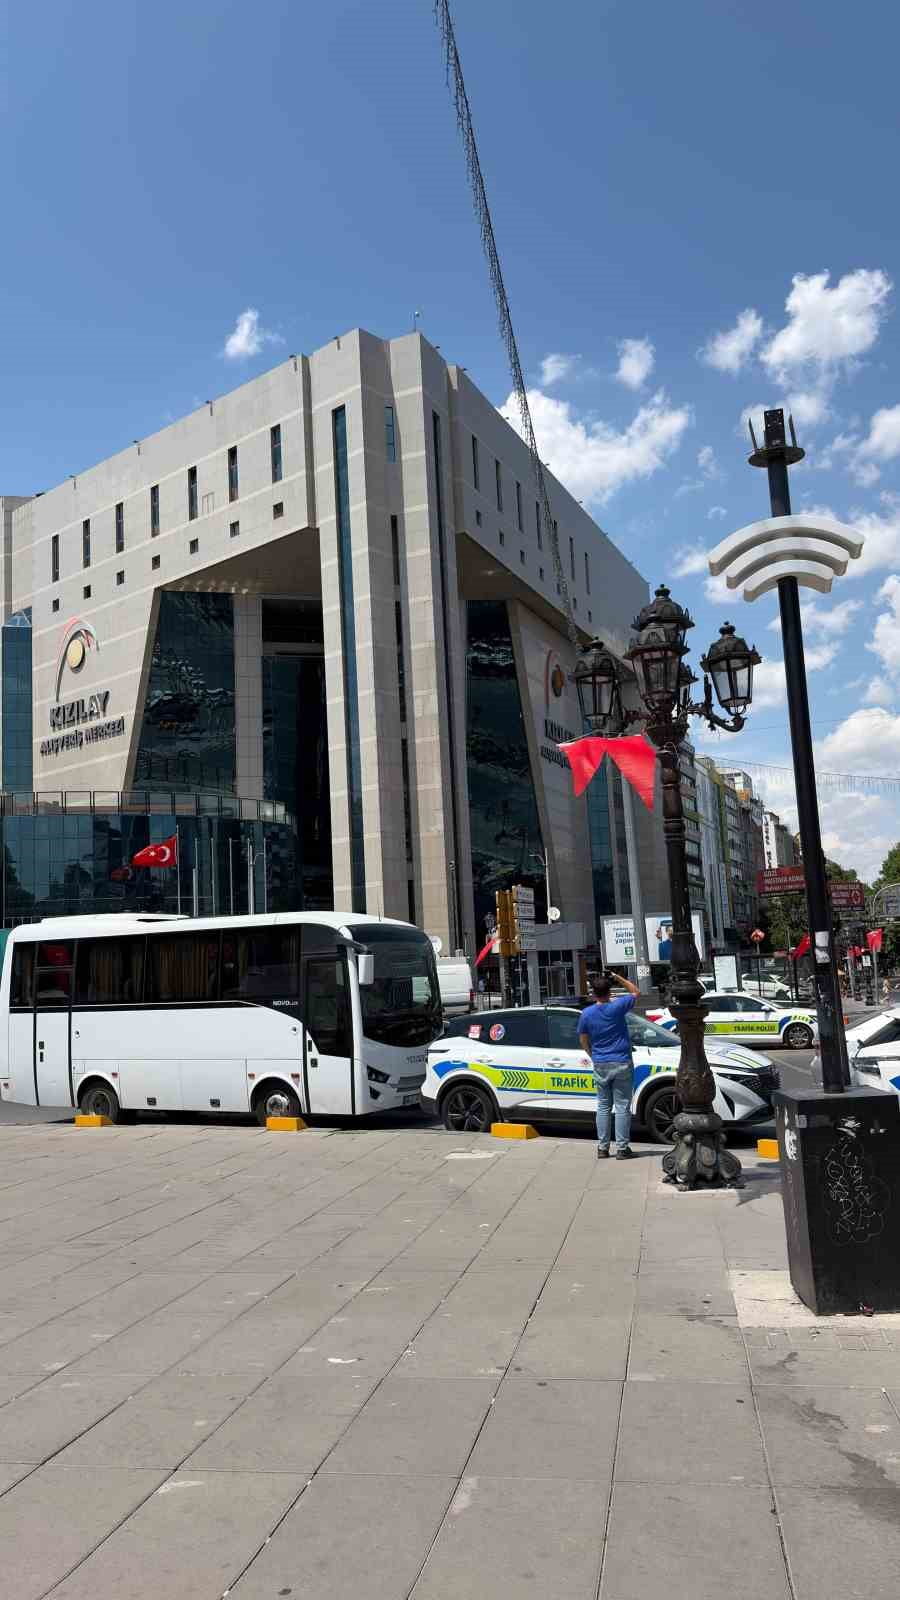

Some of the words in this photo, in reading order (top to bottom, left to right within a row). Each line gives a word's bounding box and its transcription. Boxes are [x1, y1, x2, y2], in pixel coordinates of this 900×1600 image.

[50, 690, 110, 731] KIZILAY
[40, 730, 83, 757] ALIŞVERİŞ
[84, 715, 125, 744] MERKEZİ
[550, 1076, 589, 1089] TRAFİK
